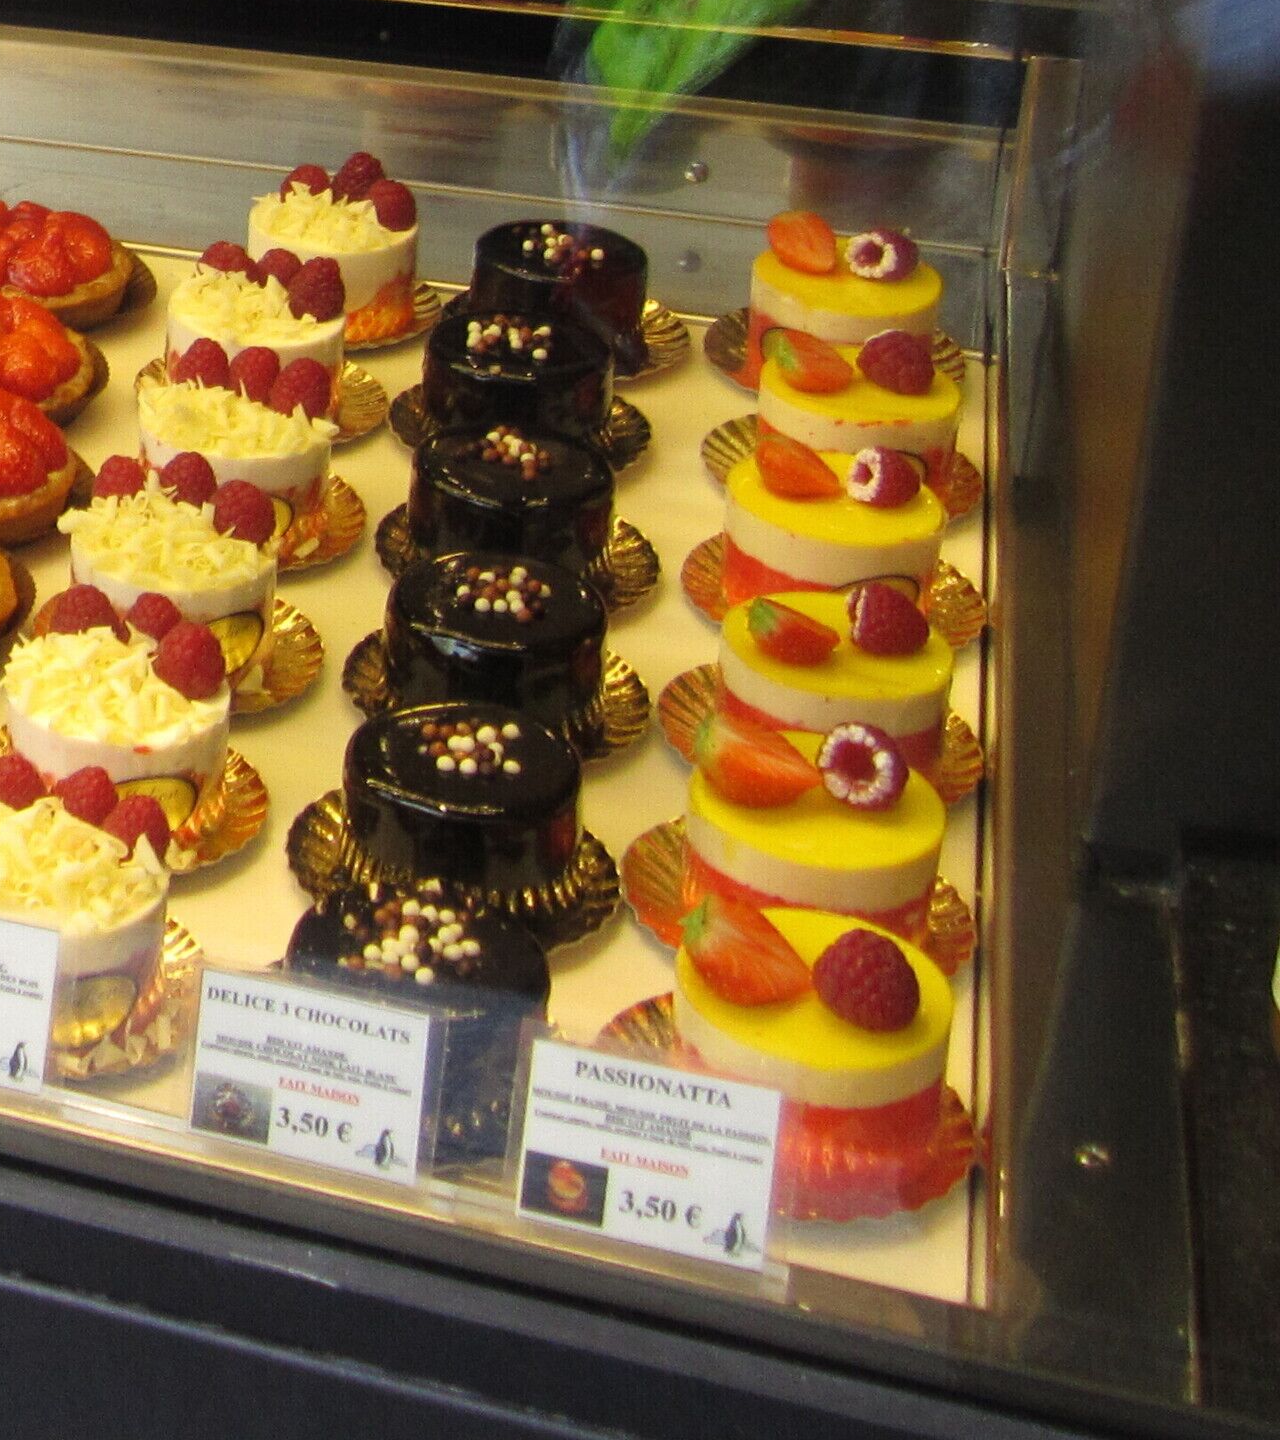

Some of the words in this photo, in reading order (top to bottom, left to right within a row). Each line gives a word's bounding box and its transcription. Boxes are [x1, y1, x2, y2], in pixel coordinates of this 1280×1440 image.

[207, 985, 275, 1013] DELICE
[282, 1002, 288, 1015] 3
[294, 1005, 410, 1045] CHOCOLATS
[575, 1059, 732, 1110] PASSIONATTA
[275, 1106, 329, 1142] 3,50
[336, 1120, 352, 1144] €
[619, 1188, 676, 1225] 3,50
[684, 1203, 702, 1229] €
